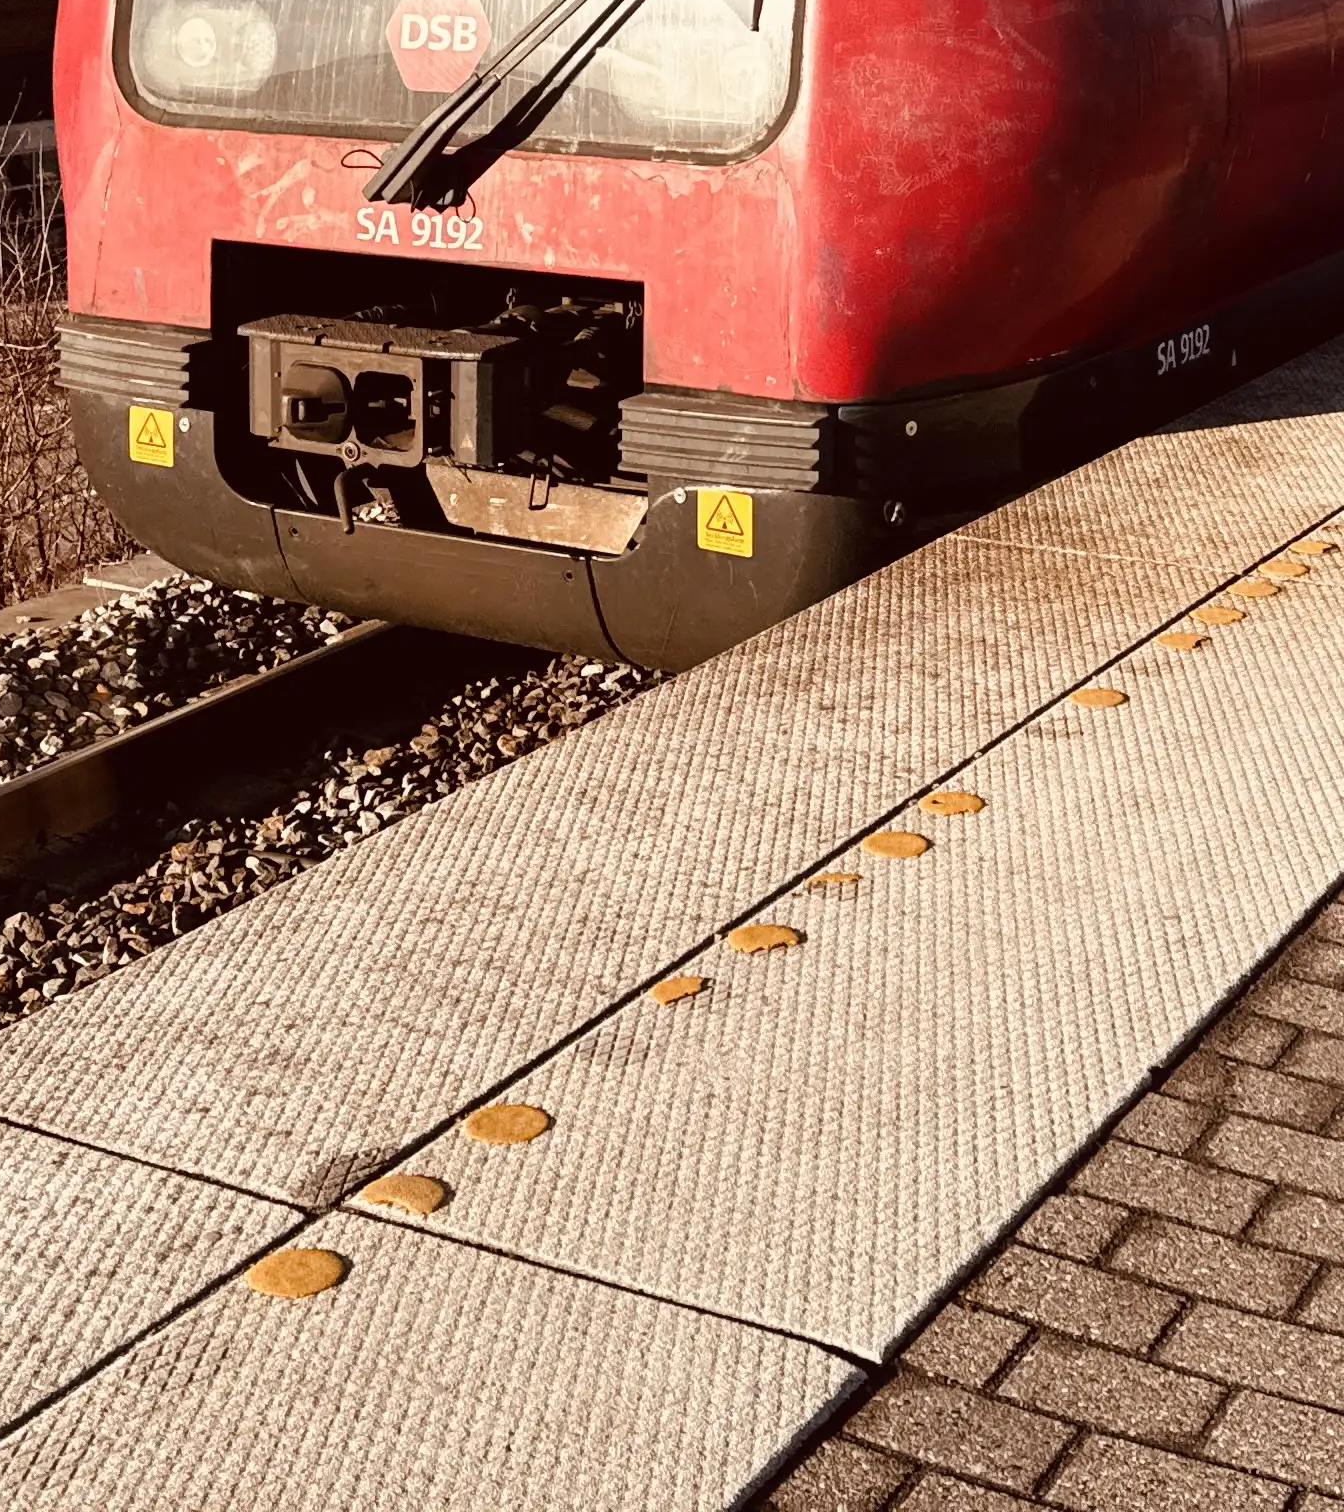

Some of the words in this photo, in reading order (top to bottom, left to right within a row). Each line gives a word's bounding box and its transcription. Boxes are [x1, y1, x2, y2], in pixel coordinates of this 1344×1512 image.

[400, 13, 477, 52] DSB
[356, 207, 400, 245] SA
[411, 212, 484, 250] 9192
[1157, 339, 1177, 375] SA
[1180, 324, 1210, 365] 9192
